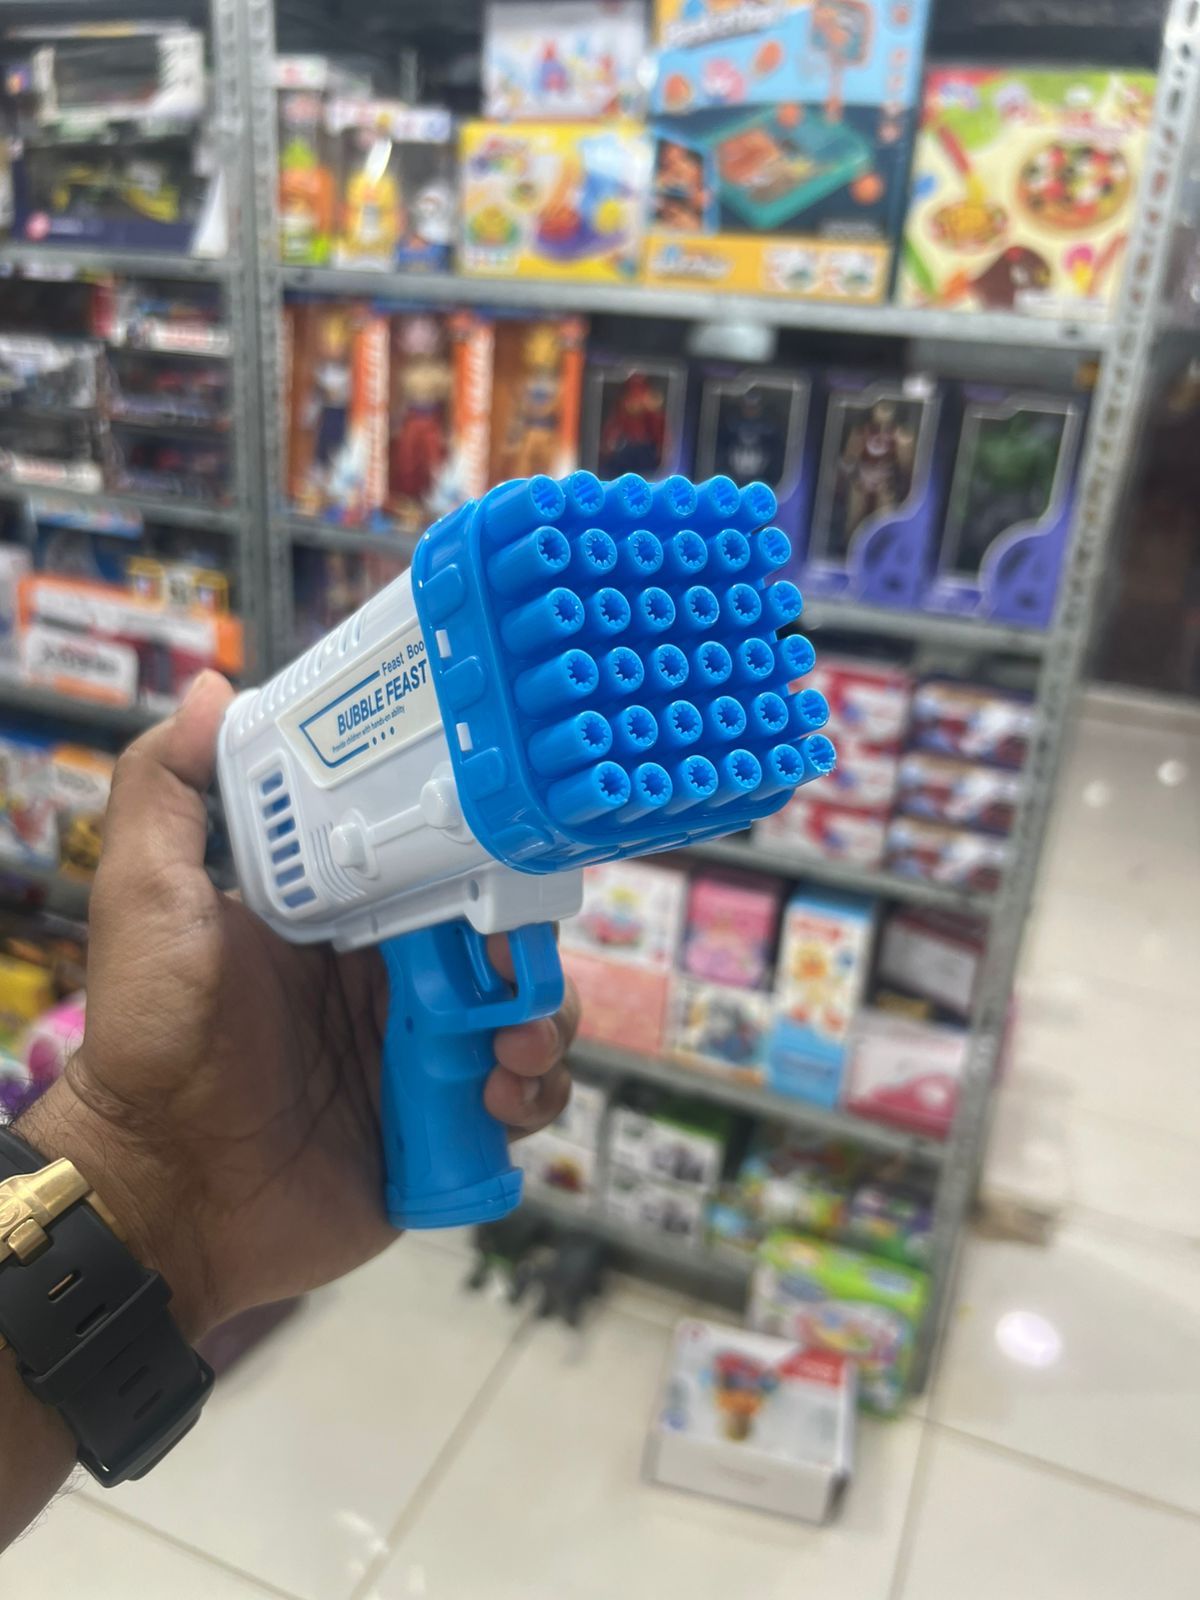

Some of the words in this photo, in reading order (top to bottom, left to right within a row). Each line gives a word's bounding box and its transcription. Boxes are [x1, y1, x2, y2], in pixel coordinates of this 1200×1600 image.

[381, 651, 405, 676] Feast
[337, 688, 385, 736] BUBBLE
[385, 658, 427, 706] FEAST
